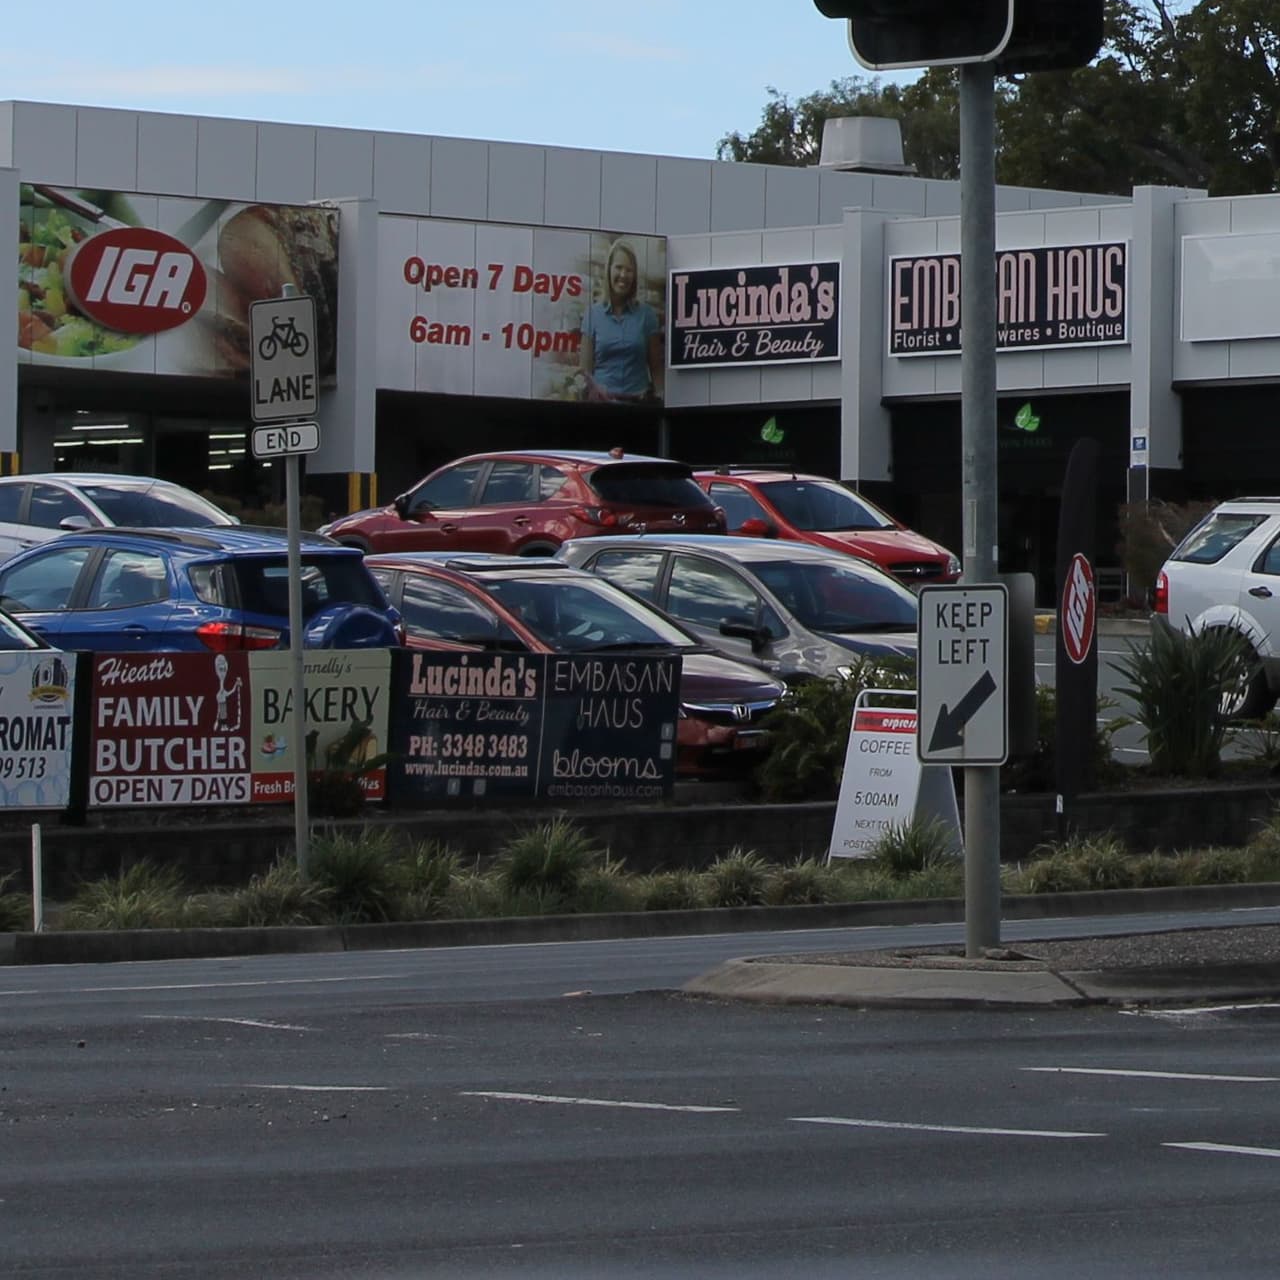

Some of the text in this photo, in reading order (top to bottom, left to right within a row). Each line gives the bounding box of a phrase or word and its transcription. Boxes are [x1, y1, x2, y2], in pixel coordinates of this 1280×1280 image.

[87, 246, 194, 314] IGA
[403, 256, 582, 297] Open 7 Days
[894, 245, 1123, 331] EMBAN HAUS
[674, 265, 835, 329] Lucinda's
[409, 317, 470, 346] 6am
[501, 324, 579, 354] 10pm
[683, 330, 825, 360] Hair & Beauty
[894, 331, 940, 350] Florist
[1058, 322, 1123, 341] Boutique
[255, 373, 315, 404] LANE
[265, 429, 302, 451] END
[936, 602, 993, 629] KEEP
[1066, 558, 1093, 657] IGA
[938, 638, 990, 665] LEFT
[98, 656, 175, 688] Hieatts
[303, 654, 353, 679] nnelly's
[410, 653, 537, 697] Lucinda's
[554, 660, 673, 694] EMBASAN
[99, 695, 205, 728] FAMILY
[413, 699, 530, 728] Hair & Beauty
[577, 698, 644, 731] HAUS
[881, 718, 918, 731] espress
[96, 736, 247, 772] BUTCHER
[409, 734, 528, 758] PH: 3348 3483
[860, 739, 912, 756] COFFEE
[16, 756, 46, 779] 513
[405, 760, 529, 778] www.lucindas.com.au
[551, 749, 664, 780] blooms
[869, 767, 893, 777] FROM
[94, 776, 246, 803] OPEN 7 DAYS
[254, 780, 282, 795] Fresh
[548, 781, 664, 800] embasanhaus.com
[854, 791, 900, 808] 5:00AM
